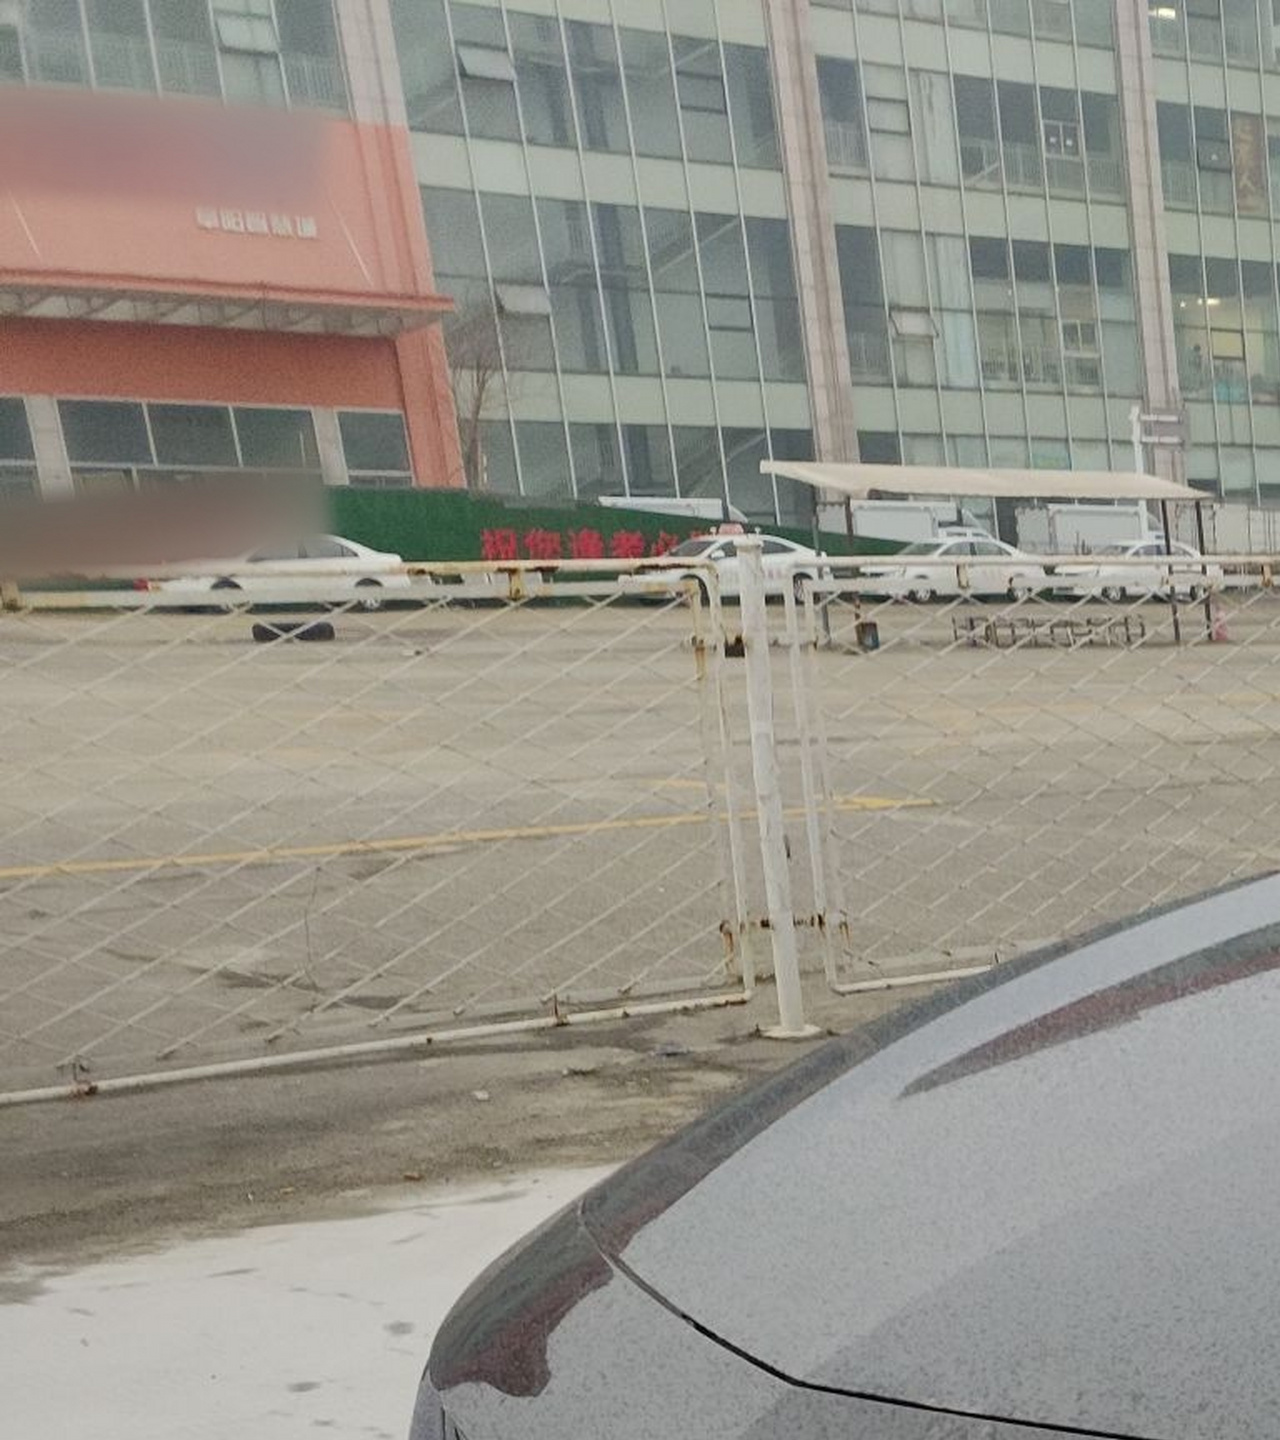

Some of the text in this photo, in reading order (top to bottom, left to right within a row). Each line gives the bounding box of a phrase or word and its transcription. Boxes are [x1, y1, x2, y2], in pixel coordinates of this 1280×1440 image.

[481, 528, 711, 560] 祝您逢考必
